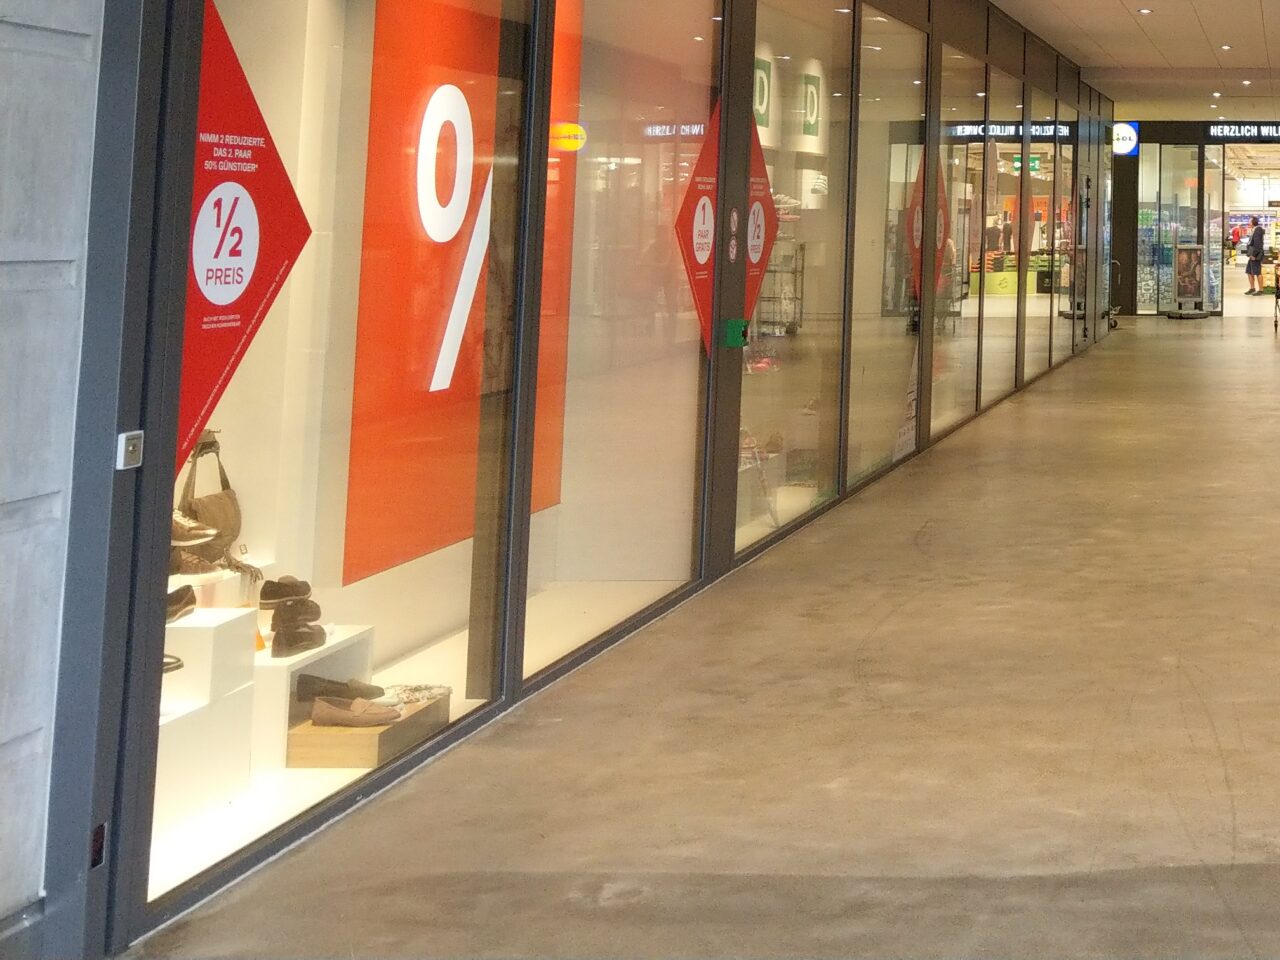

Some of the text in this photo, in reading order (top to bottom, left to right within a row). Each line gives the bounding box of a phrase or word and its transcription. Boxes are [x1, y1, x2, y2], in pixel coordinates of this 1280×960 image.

[1210, 125, 1258, 137] HERZLICH
[200, 133, 219, 144] NIMM
[220, 135, 225, 144] 2
[213, 147, 228, 157] DAS
[234, 149, 252, 159] PAAR
[204, 161, 218, 171] 50%
[205, 267, 244, 287] PREIS
